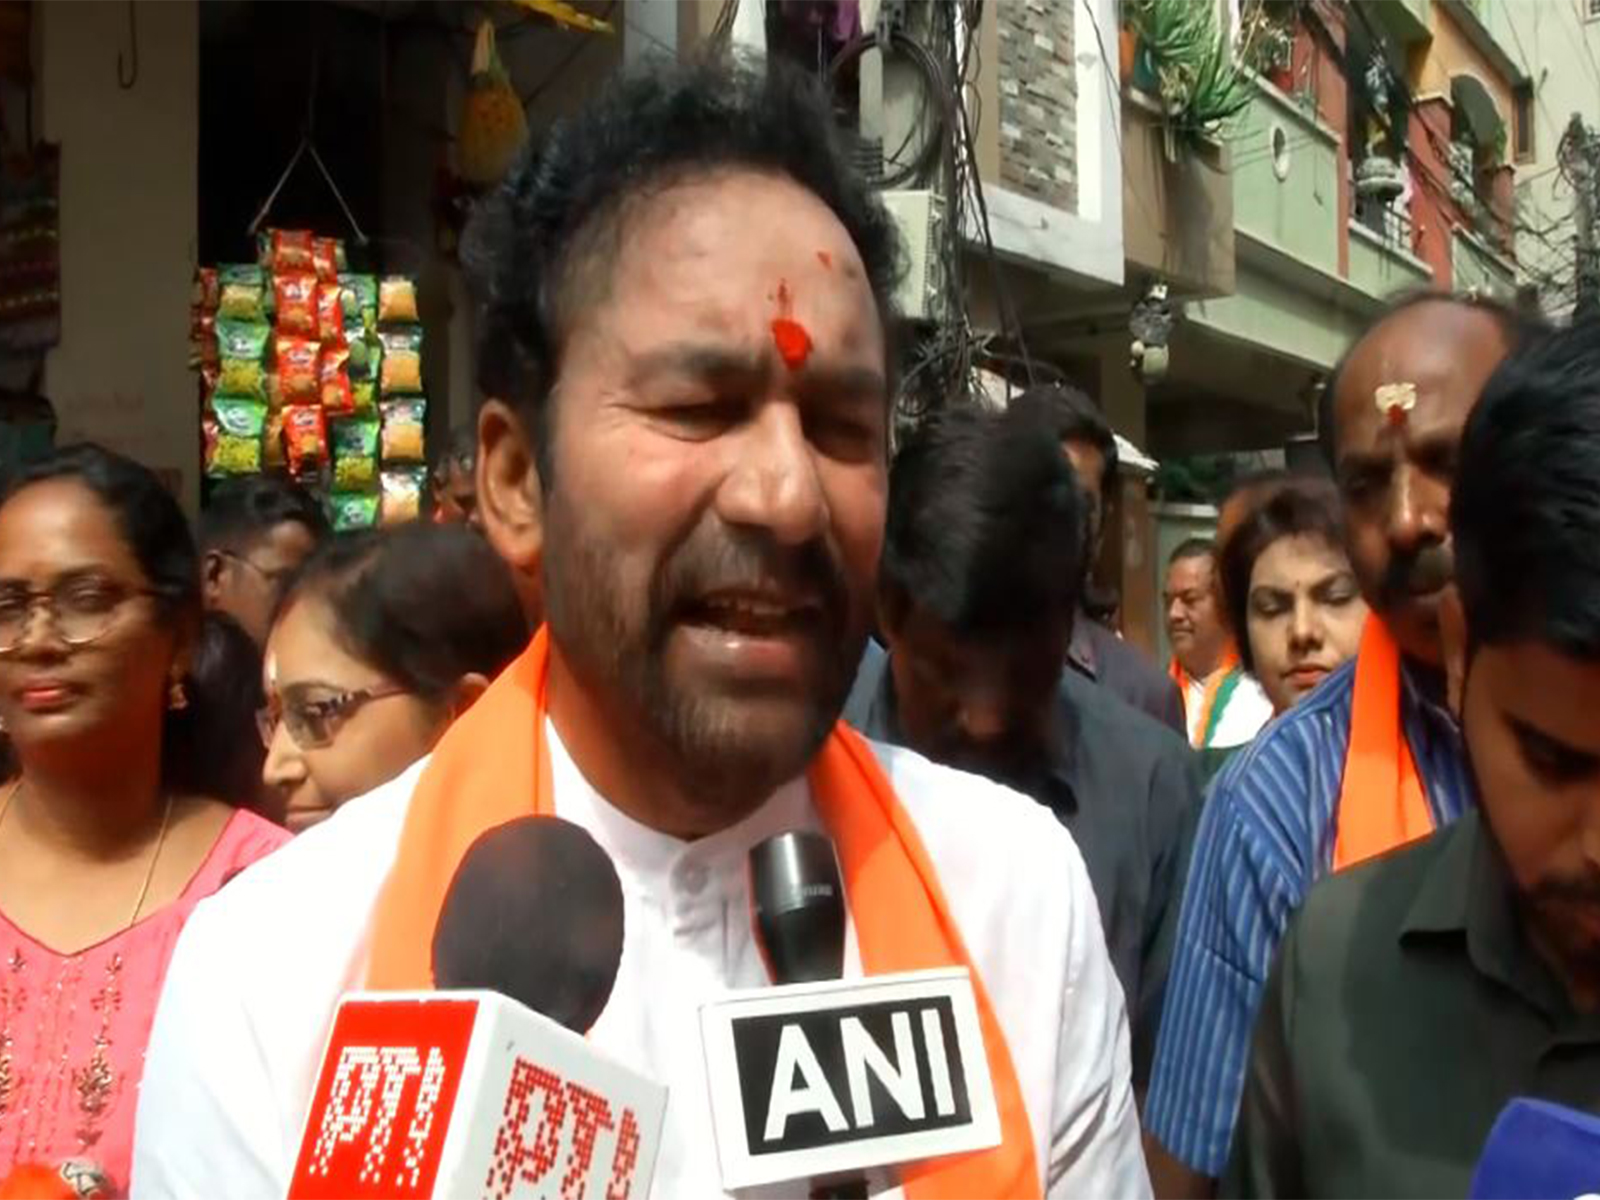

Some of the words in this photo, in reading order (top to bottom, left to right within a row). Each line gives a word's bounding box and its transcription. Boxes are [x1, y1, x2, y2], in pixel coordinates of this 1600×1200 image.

[308, 1047, 445, 1187] PTI
[482, 1056, 640, 1200] PTI
[763, 1008, 956, 1141] ANI
